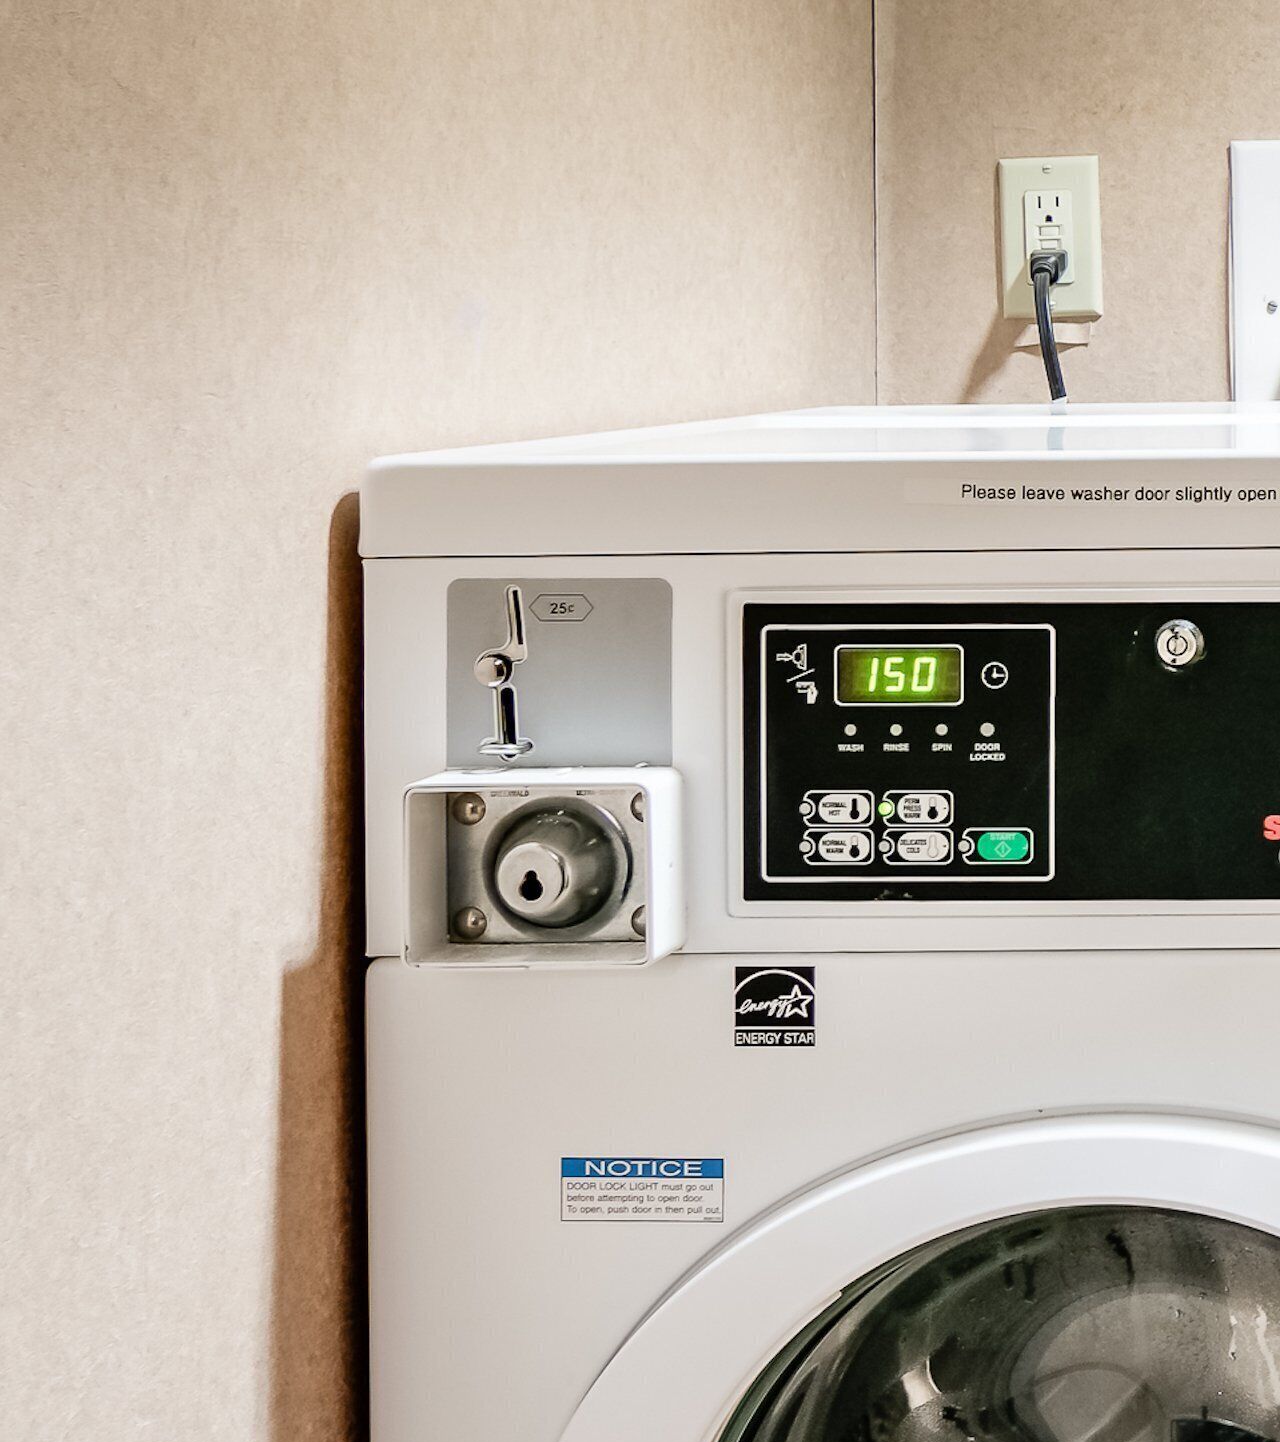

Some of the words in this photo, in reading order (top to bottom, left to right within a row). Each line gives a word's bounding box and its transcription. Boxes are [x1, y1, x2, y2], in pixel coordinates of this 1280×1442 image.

[962, 484, 1016, 499] Please
[1022, 485, 1065, 500] leave
[1071, 486, 1130, 500] washer
[1135, 487, 1170, 500] door
[1176, 486, 1232, 503] slightly
[1238, 490, 1276, 502] open
[868, 656, 937, 692] 150
[736, 1032, 781, 1045] ENERGY
[784, 1032, 814, 1045] STAR
[585, 1160, 703, 1176] NOTICE
